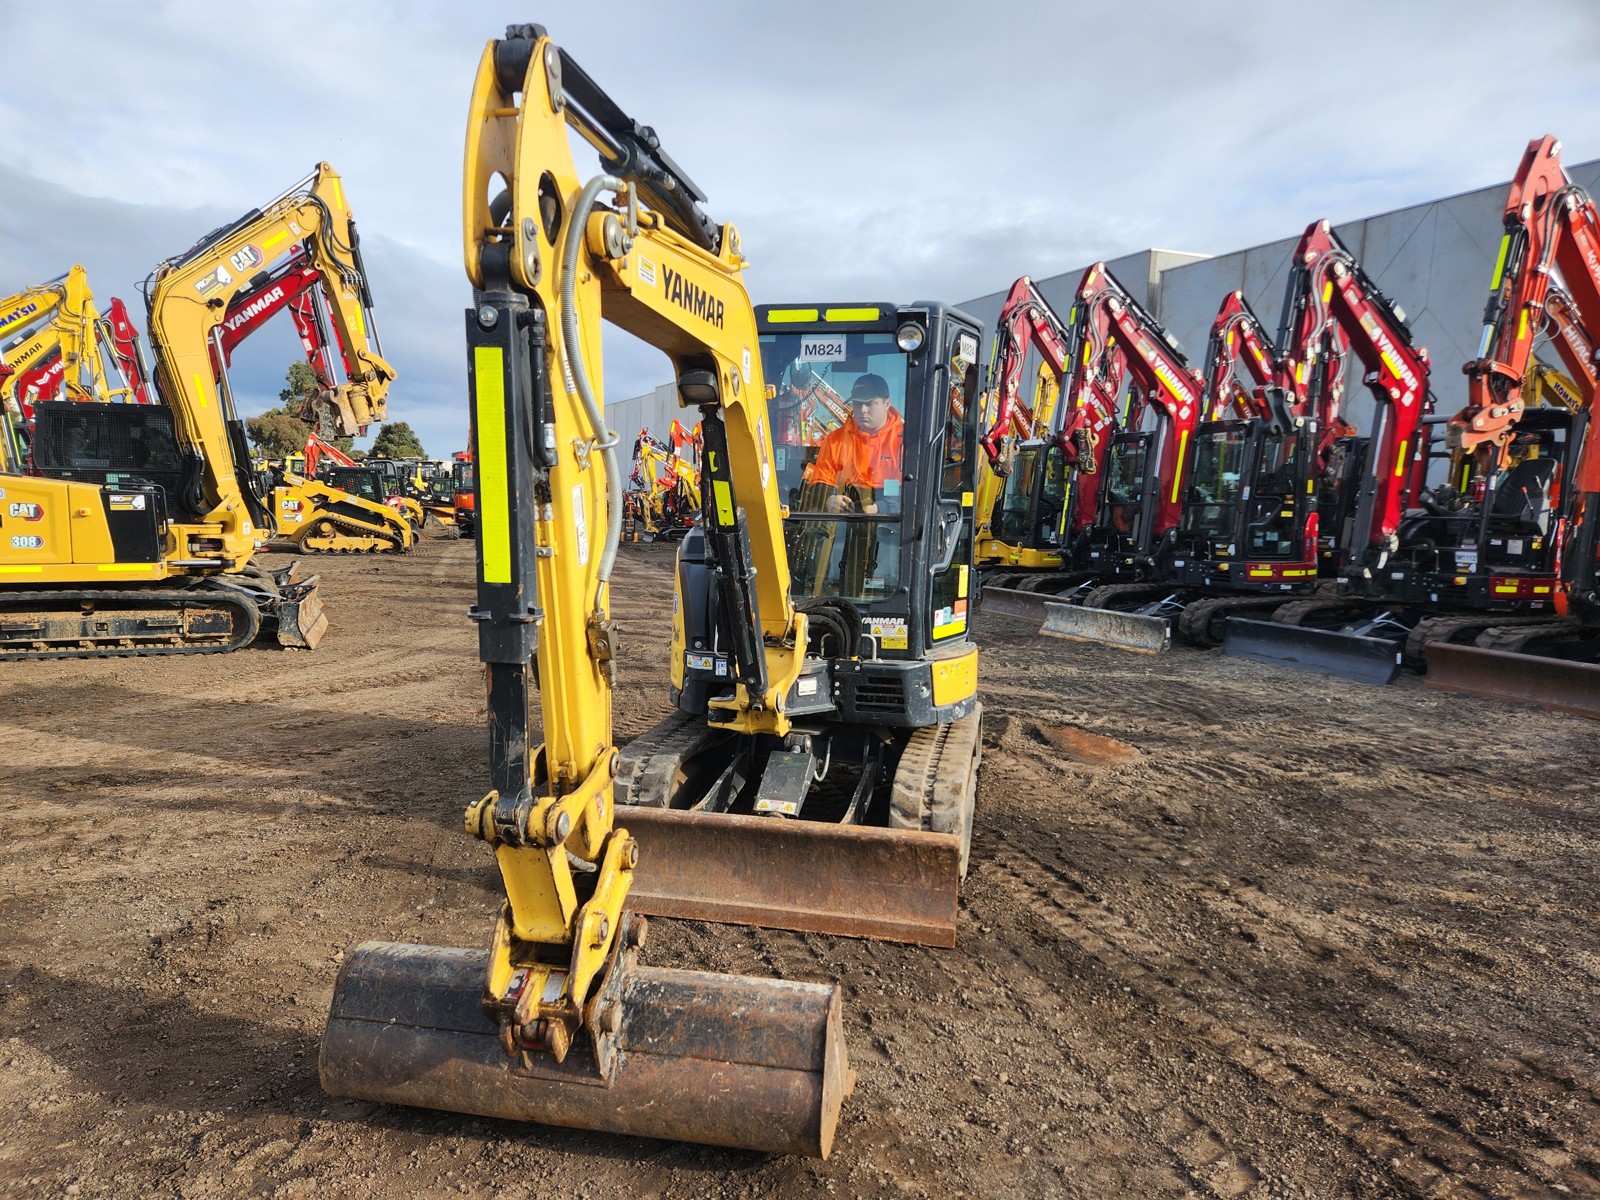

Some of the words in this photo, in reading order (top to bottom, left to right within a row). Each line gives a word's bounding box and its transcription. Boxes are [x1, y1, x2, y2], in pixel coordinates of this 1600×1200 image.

[230, 245, 257, 272] CAT
[224, 286, 285, 331] YANMAR
[662, 263, 724, 330] YANMAR
[8, 342, 43, 369] ANMAR
[804, 343, 843, 356] M824
[1378, 333, 1419, 392] YANMAR
[1154, 355, 1195, 405] YANMAR
[1554, 382, 1580, 412] KOMATS
[9, 503, 37, 518] CAT
[281, 500, 300, 510] CAT
[11, 536, 37, 548] 308
